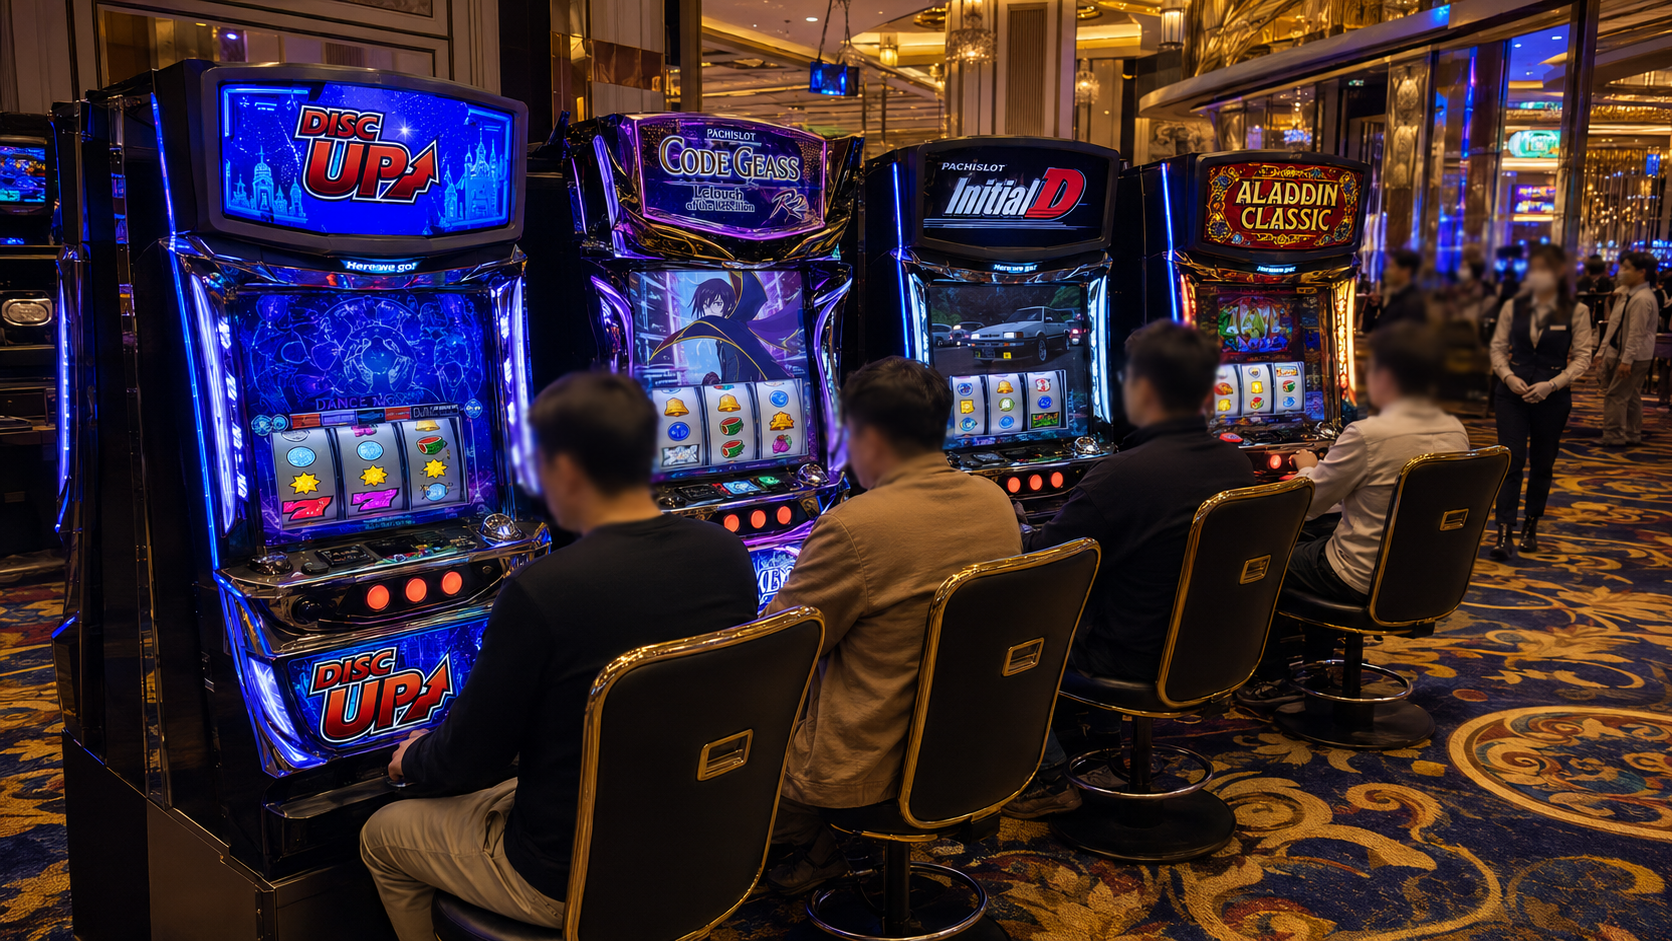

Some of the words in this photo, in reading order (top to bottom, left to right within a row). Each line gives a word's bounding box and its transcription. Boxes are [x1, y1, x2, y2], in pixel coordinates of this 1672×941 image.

[296, 106, 383, 141] DISC
[706, 128, 757, 142] PACHISLOT
[304, 139, 412, 201] UP
[659, 136, 731, 176] CODE
[733, 146, 801, 182] GEASS
[941, 162, 1006, 172] PACHISLOT
[944, 176, 1041, 217] Initial
[1024, 167, 1087, 220] D
[1235, 181, 1339, 207] ALADDIN
[1241, 207, 1333, 231] CLASSIC
[309, 647, 396, 694] DISC
[320, 669, 424, 743] UP
